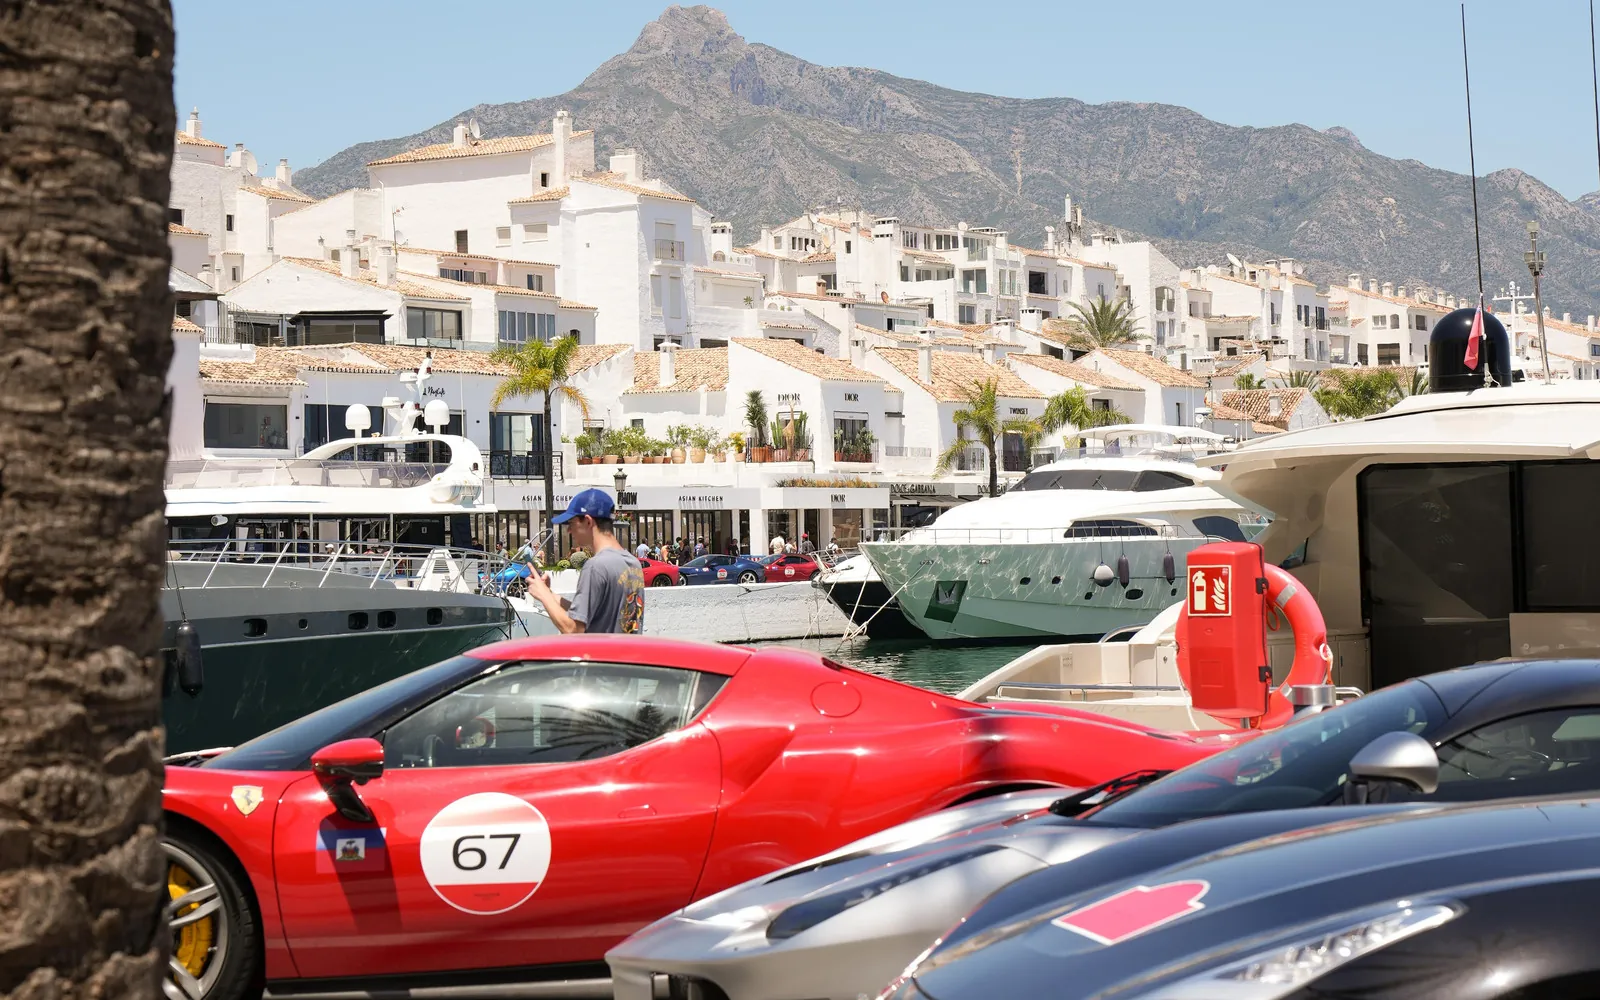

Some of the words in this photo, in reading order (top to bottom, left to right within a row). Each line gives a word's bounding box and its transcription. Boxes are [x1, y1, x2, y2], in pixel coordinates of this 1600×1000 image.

[777, 393, 800, 402] DIOR
[844, 393, 859, 402] DIOR
[830, 494, 846, 503] DIOR
[452, 833, 521, 871] 67
